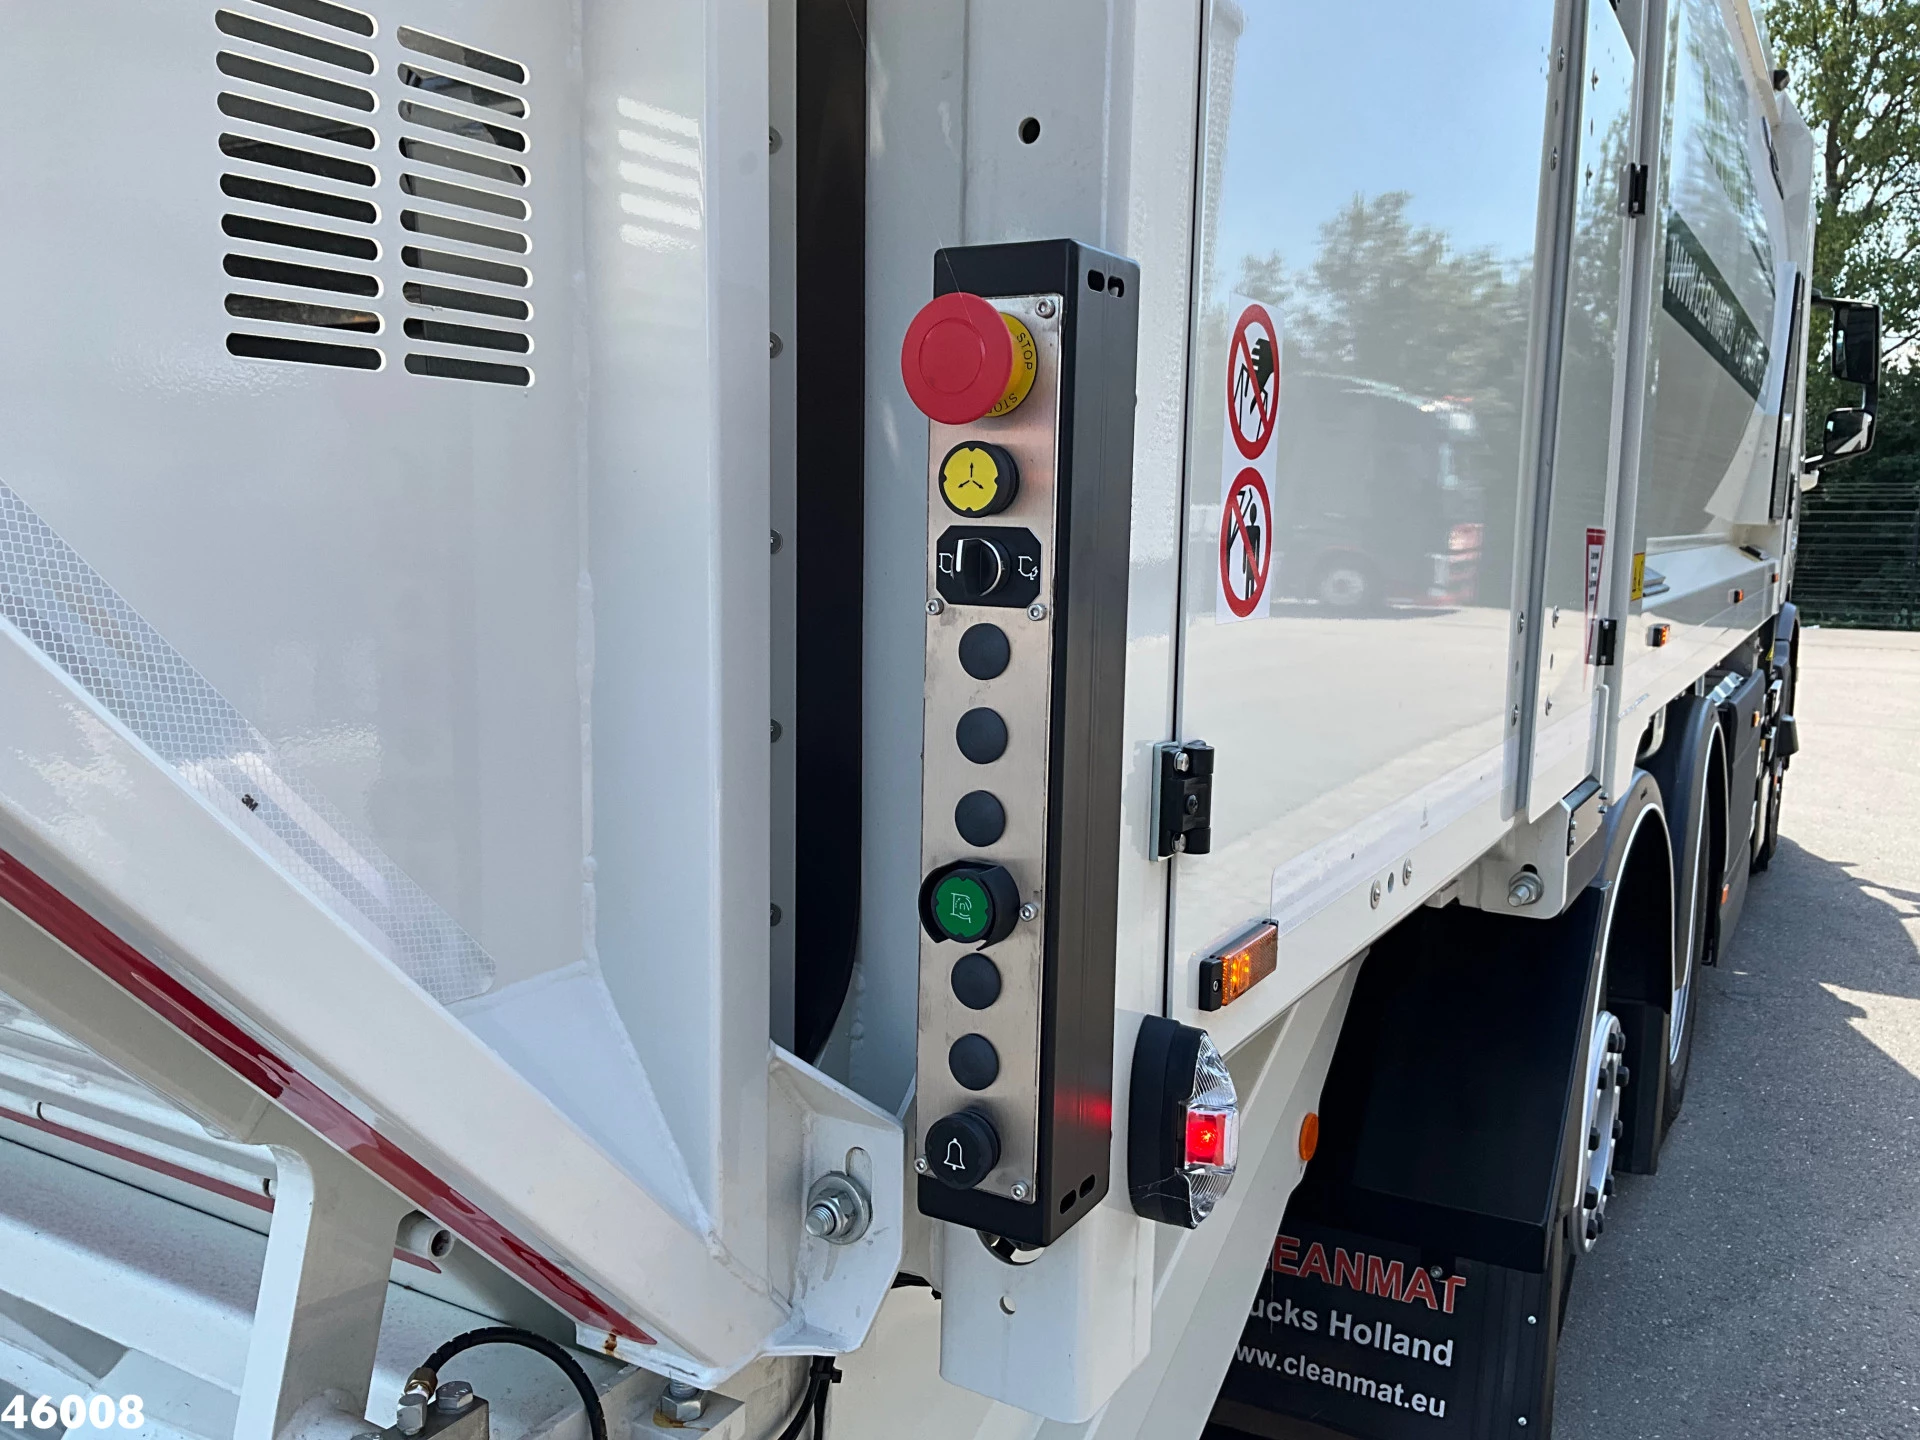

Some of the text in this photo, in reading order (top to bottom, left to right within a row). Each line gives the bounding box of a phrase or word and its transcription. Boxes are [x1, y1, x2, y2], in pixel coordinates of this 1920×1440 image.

[1017, 332, 1033, 370] STOP
[988, 393, 1018, 413] STO
[242, 793, 258, 811] 3M
[1266, 1234, 1467, 1314] EANMAT
[1249, 1298, 1454, 1367] ucks Holland
